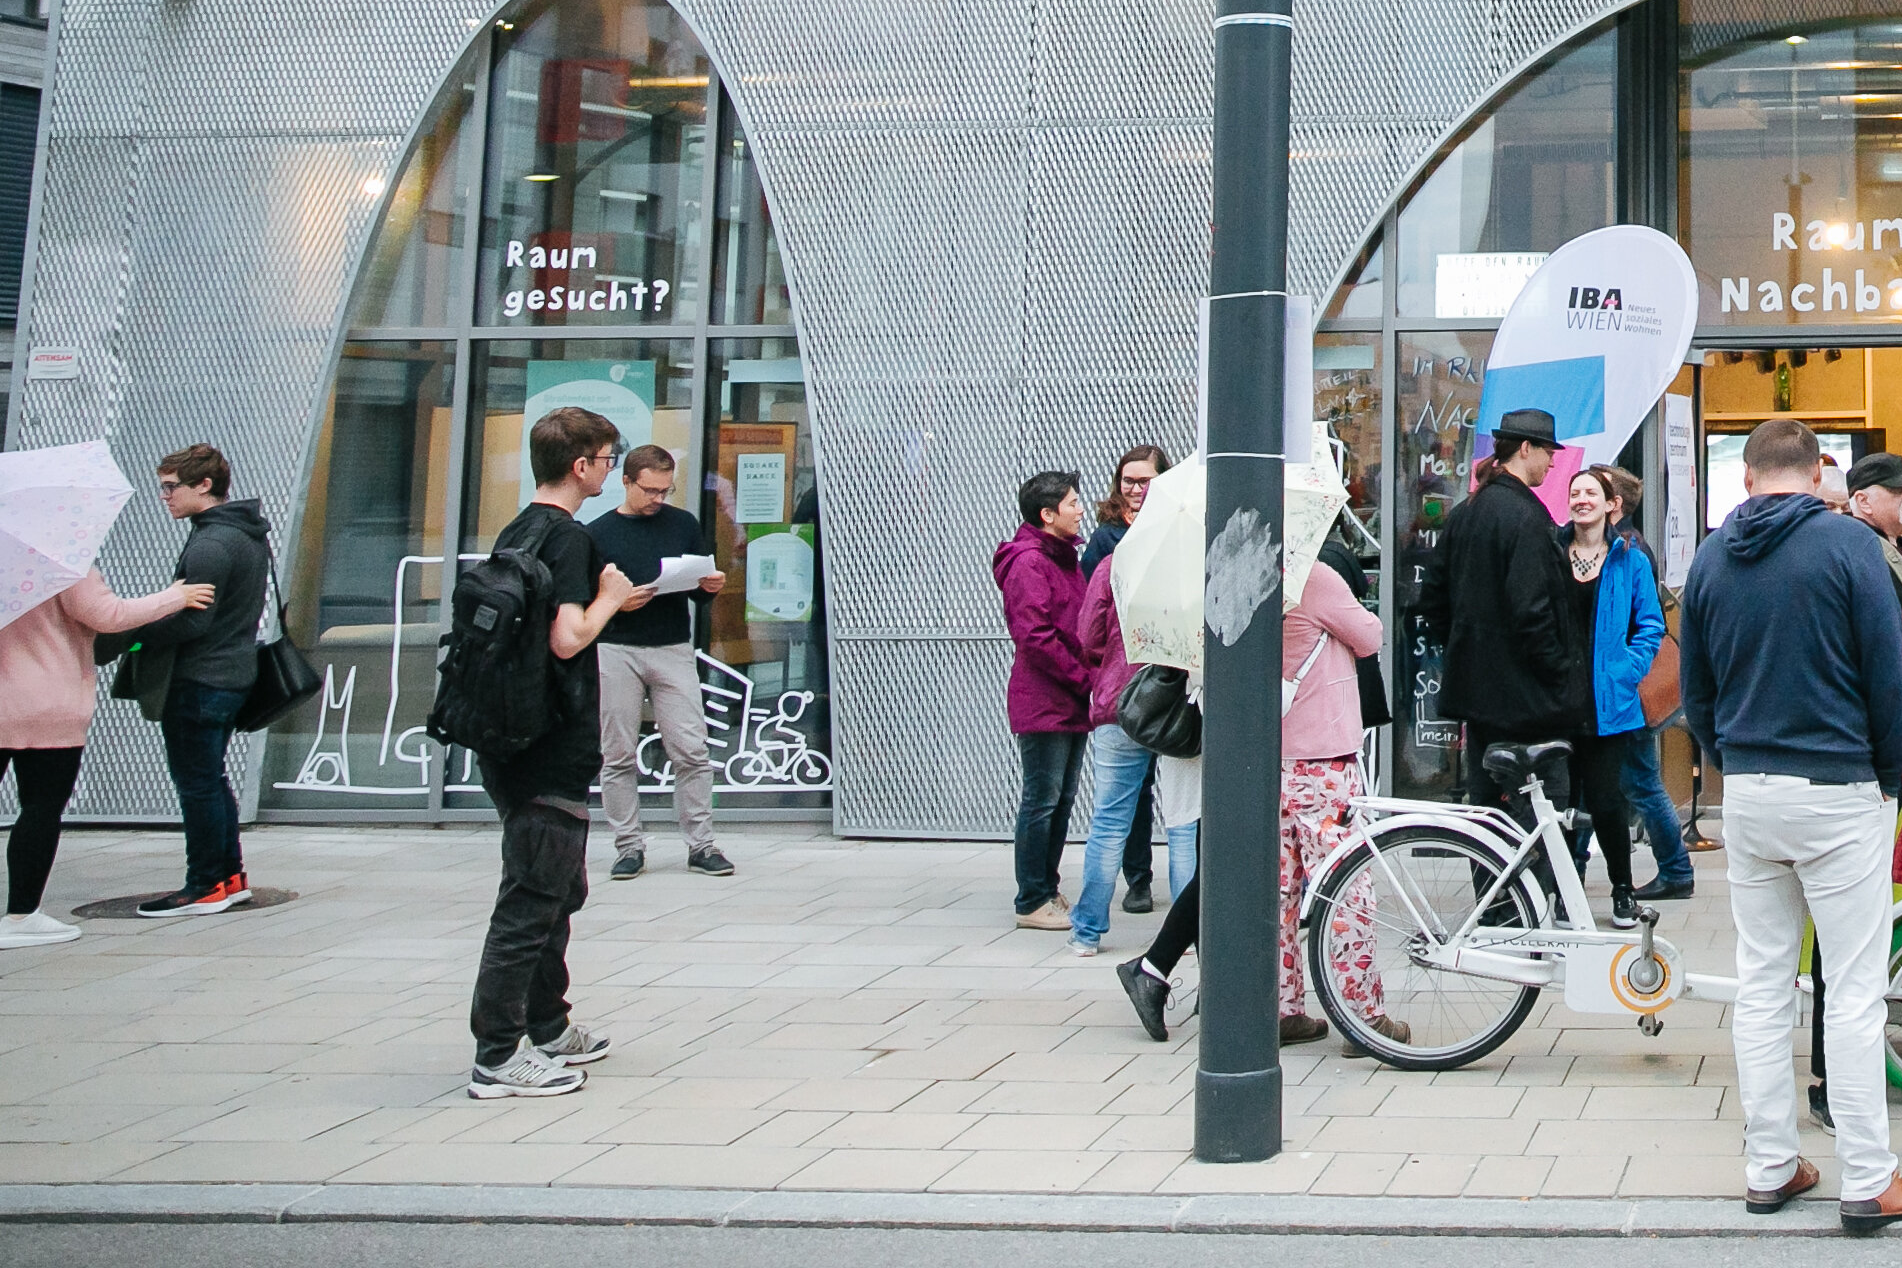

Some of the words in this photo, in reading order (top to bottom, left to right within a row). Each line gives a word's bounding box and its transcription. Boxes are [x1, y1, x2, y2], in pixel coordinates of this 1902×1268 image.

[506, 240, 596, 269] Raum
[503, 279, 670, 317] gesucht?
[1568, 287, 1623, 311] IBA
[1628, 304, 1657, 314] Neues
[1566, 311, 1623, 331] WIEN
[1626, 314, 1662, 326] soziales
